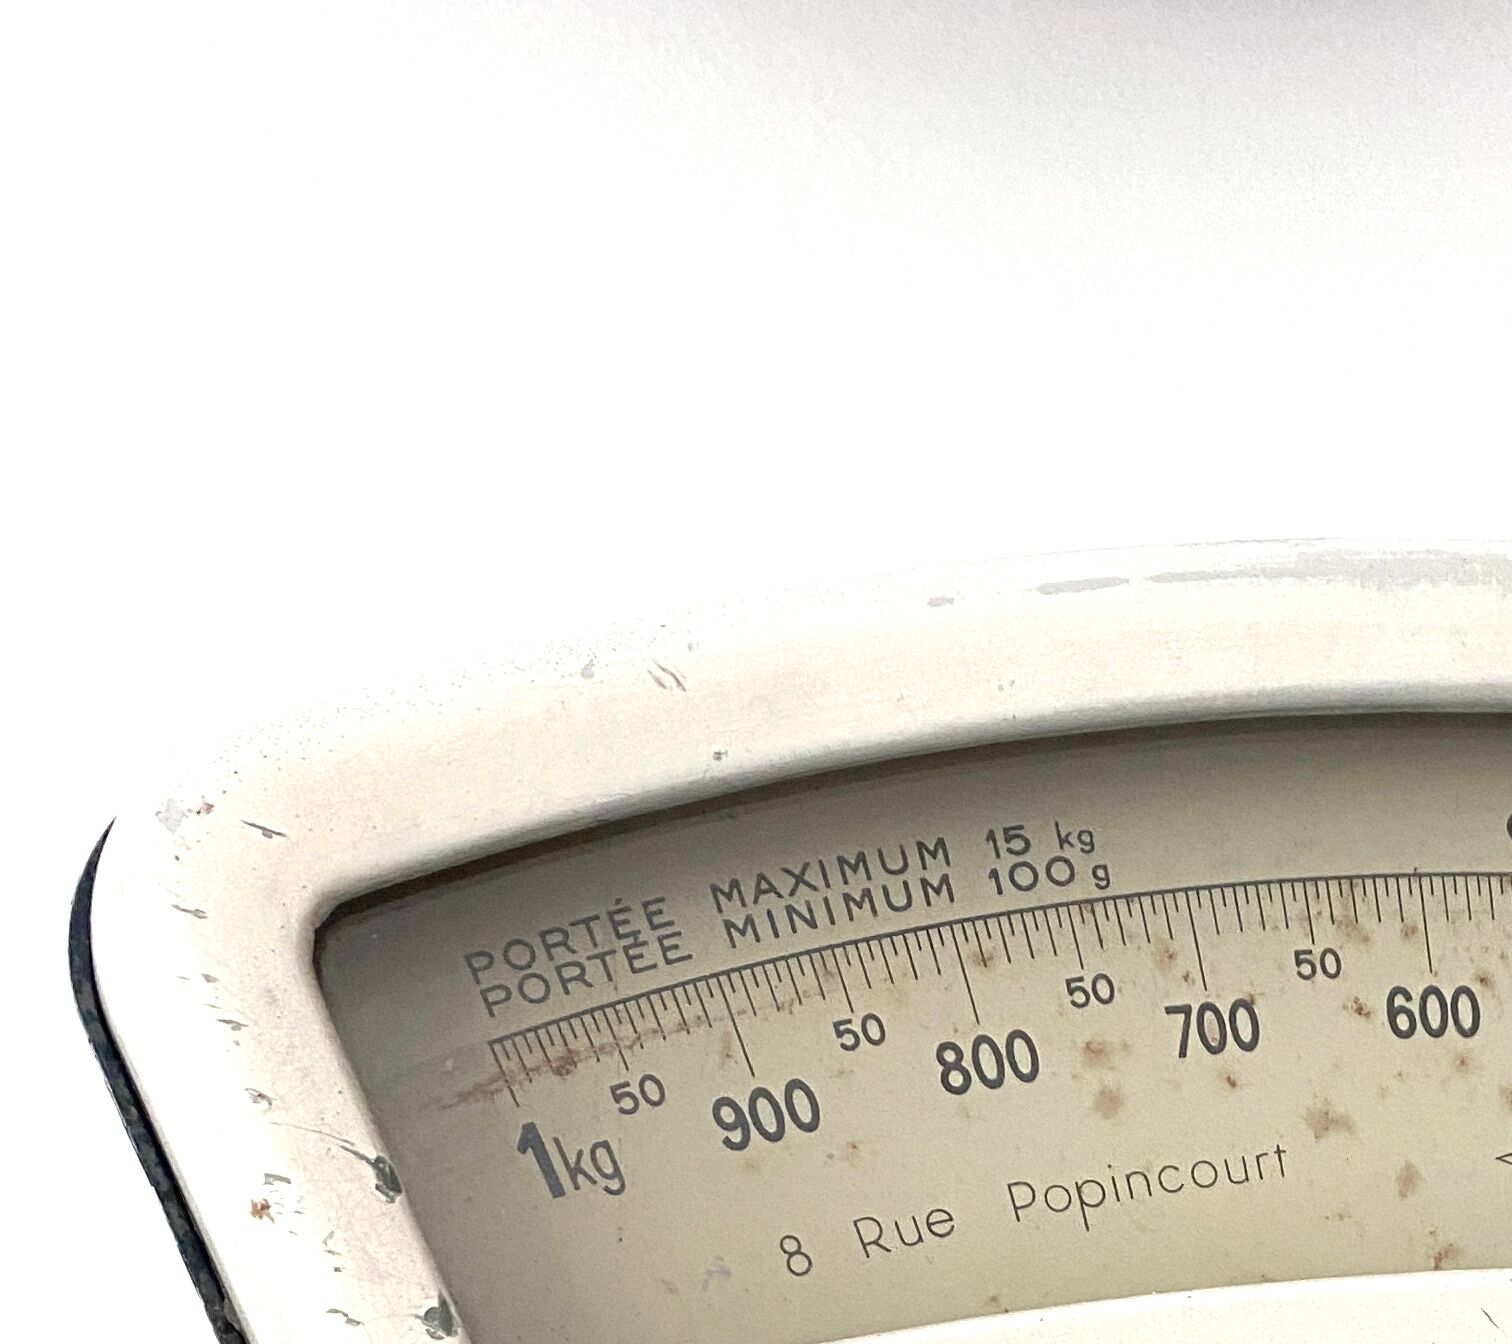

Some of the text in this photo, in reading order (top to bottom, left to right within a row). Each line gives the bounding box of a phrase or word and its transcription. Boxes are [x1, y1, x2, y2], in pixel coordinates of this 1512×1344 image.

[464, 821, 1095, 985] PORTÉE MAXIMUM 15 kg
[723, 873, 956, 949] MINIMUM
[988, 855, 1076, 895] 100
[1093, 862, 1110, 890] g
[516, 1123, 627, 1199] 1kg
[610, 1074, 666, 1115] 50
[712, 1079, 820, 1151] 900
[832, 1013, 886, 1052] 50
[935, 1030, 1040, 1096] 800
[1066, 973, 1115, 1009] 50
[1164, 999, 1260, 1058] 700
[1293, 947, 1342, 981] 50
[1387, 985, 1481, 1039] 600
[780, 1143, 1287, 1276] 8 Rue Popincourt
